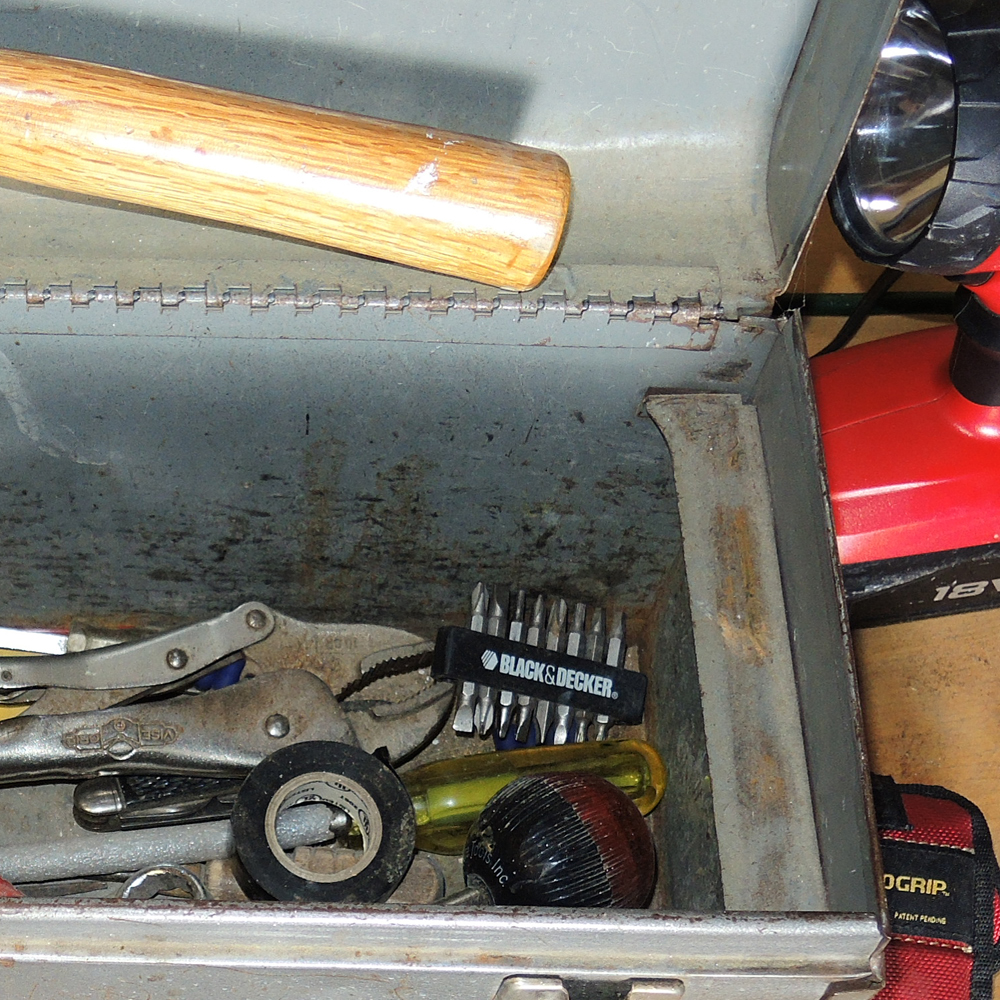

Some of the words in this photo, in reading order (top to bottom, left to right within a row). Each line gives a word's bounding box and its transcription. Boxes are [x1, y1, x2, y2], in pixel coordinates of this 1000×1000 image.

[933, 578, 1000, 602] 18
[499, 653, 614, 698] BLACK&DECKER
[491, 858, 509, 888] Inc.
[894, 911, 919, 922] PATENT
[920, 914, 948, 925] PENDING
